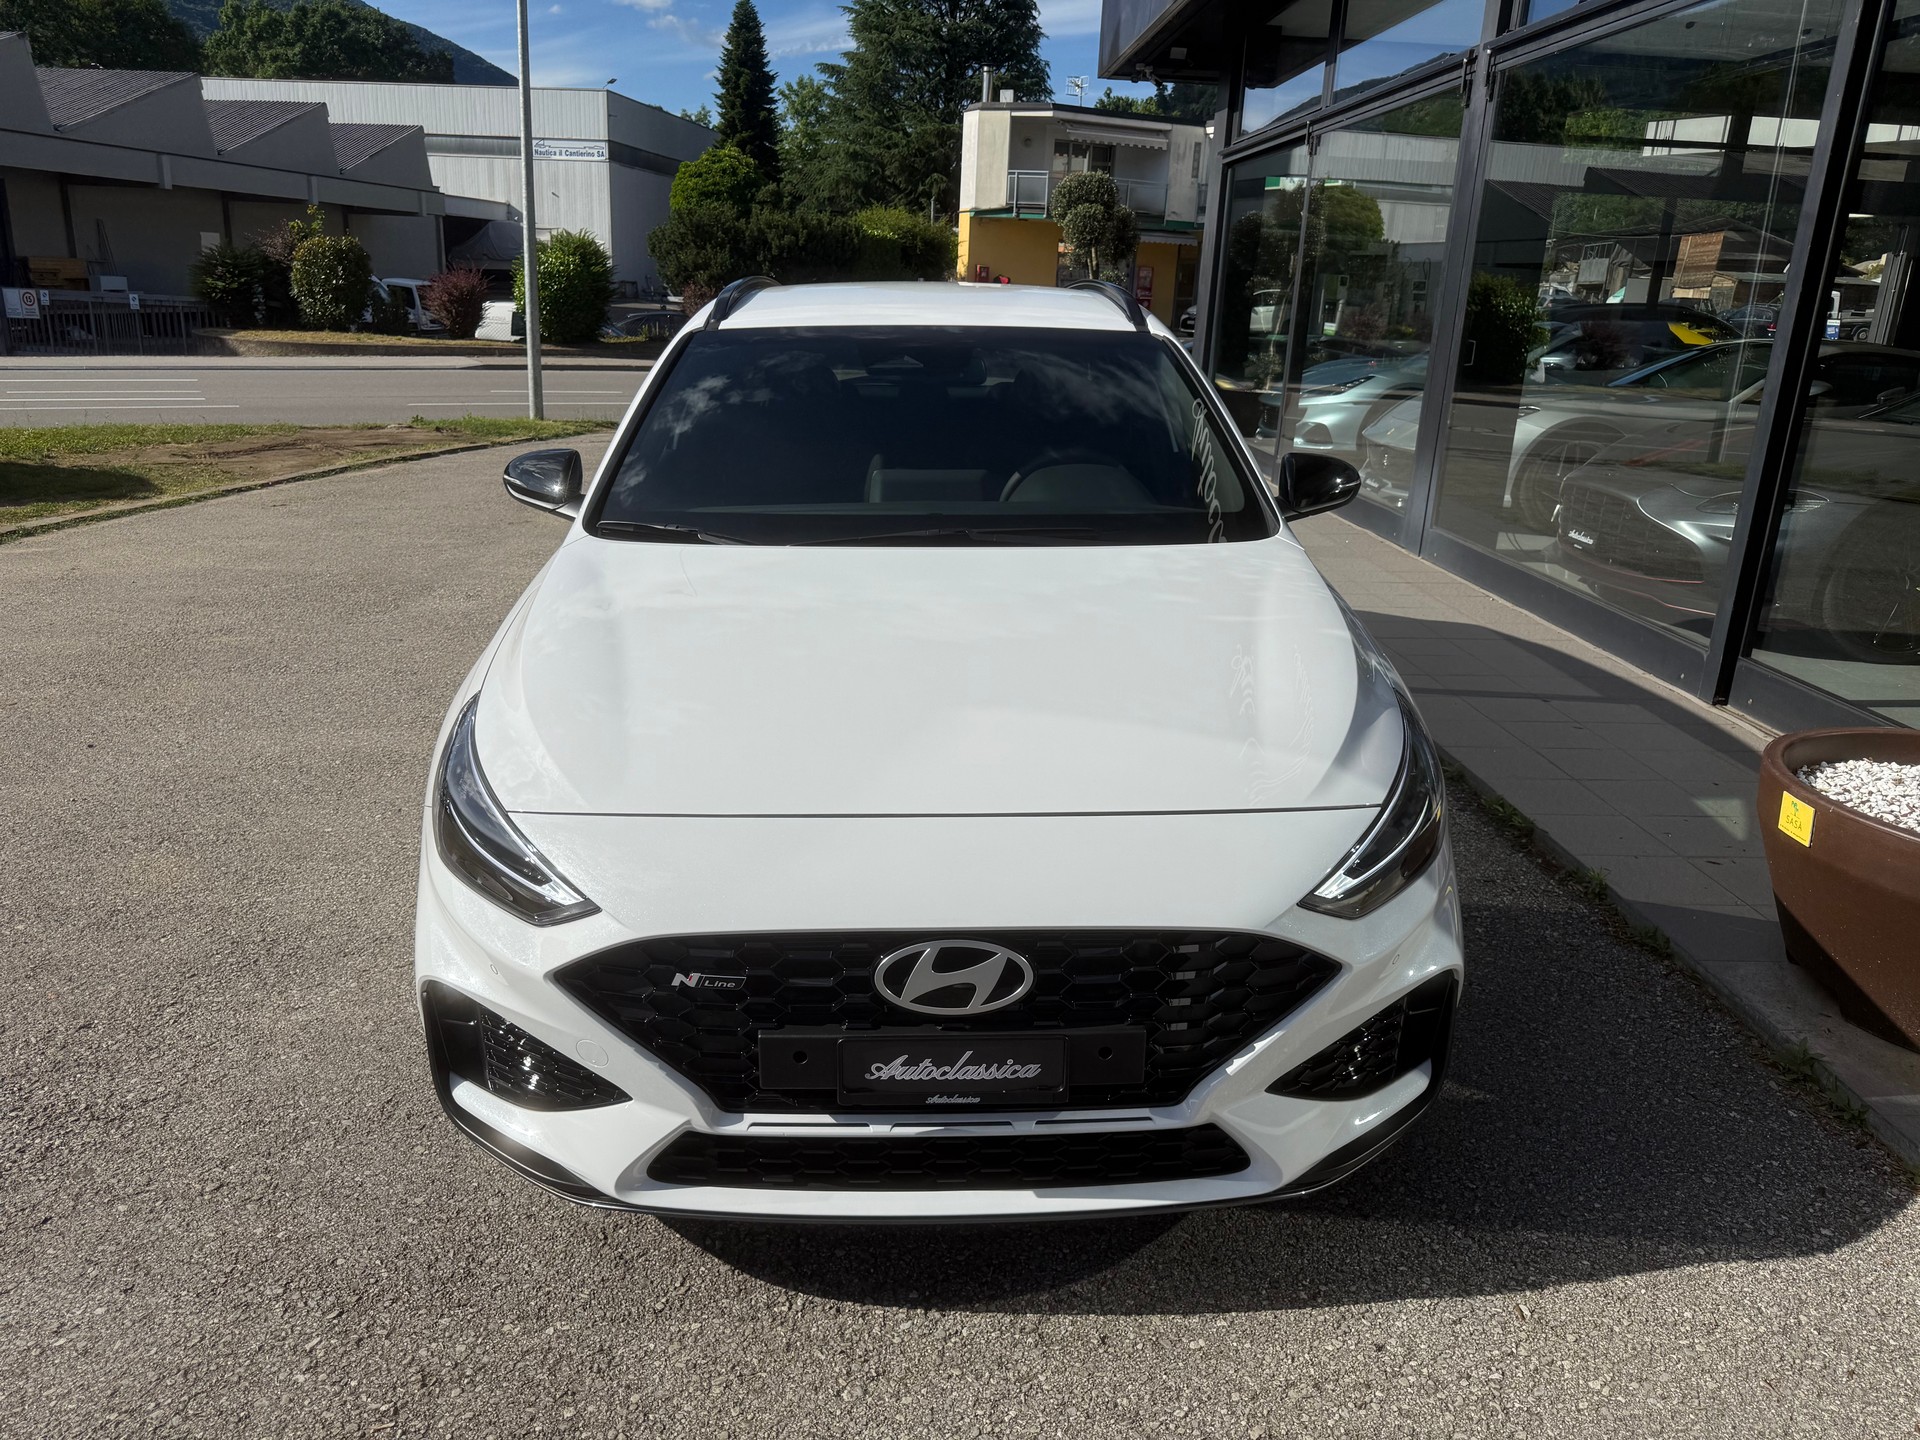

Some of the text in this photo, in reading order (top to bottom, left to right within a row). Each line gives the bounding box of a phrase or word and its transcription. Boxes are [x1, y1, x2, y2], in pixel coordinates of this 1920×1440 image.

[564, 149, 595, 157] Cantierino
[671, 973, 701, 988] N
[865, 1051, 1042, 1080] Autoclassica
